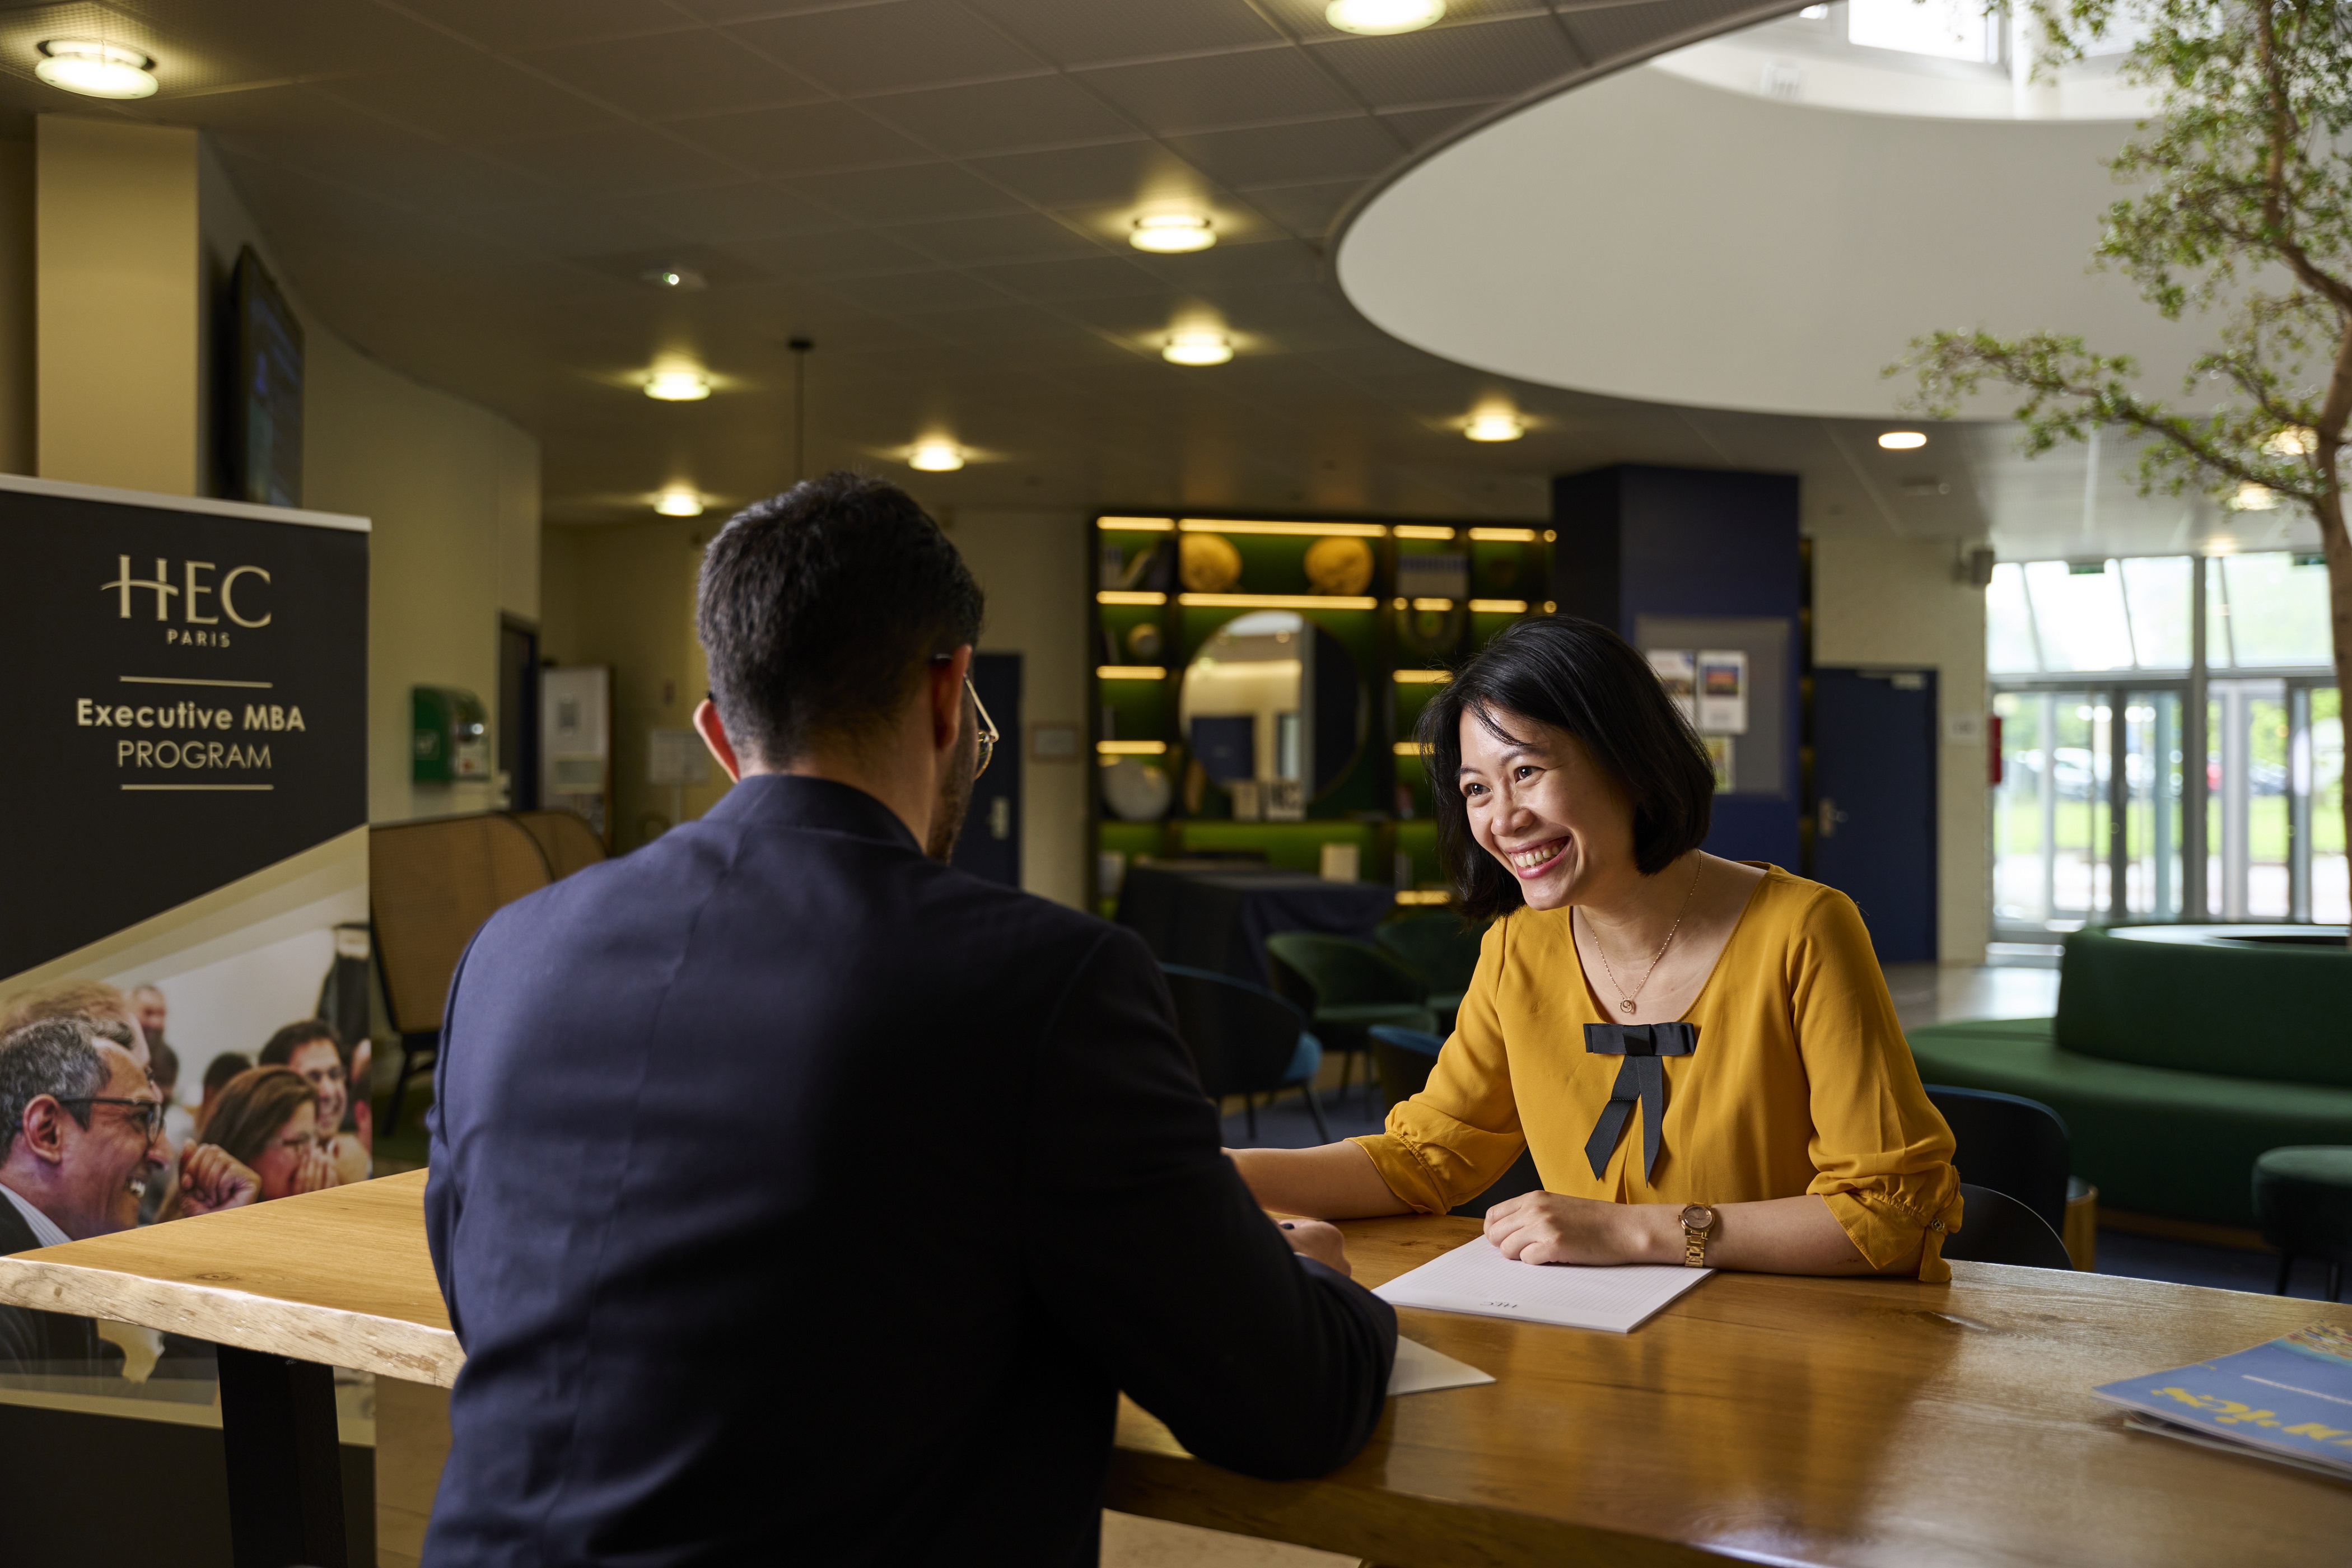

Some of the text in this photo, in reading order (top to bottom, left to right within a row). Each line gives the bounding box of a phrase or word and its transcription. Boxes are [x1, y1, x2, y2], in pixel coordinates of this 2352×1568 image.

[101, 554, 272, 628] HEC
[166, 628, 230, 648] PARIS
[77, 698, 306, 732] Executive MBA
[118, 740, 272, 769] PROGRAM
